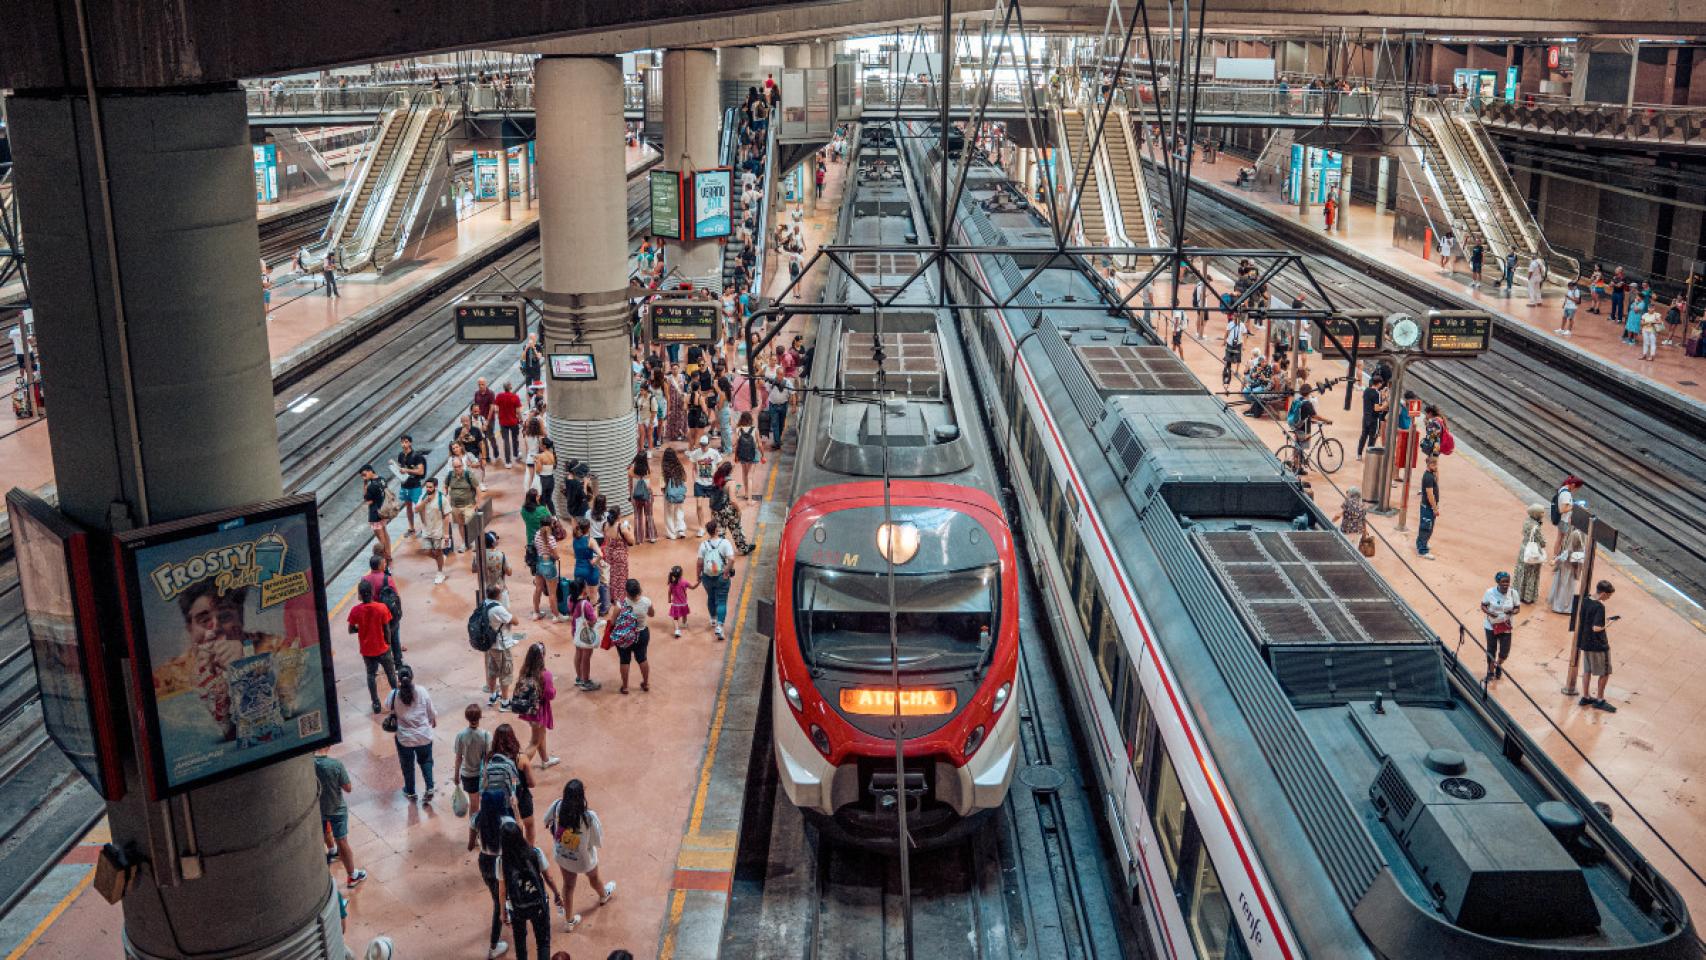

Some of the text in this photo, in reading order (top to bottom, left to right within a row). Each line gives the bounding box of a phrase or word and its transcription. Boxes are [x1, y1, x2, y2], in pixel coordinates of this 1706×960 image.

[701, 185, 726, 198] VERANO
[843, 552, 860, 567] M
[153, 543, 253, 598] FROSTY
[859, 690, 937, 705] ATOCHA
[1239, 891, 1263, 944] renfe
